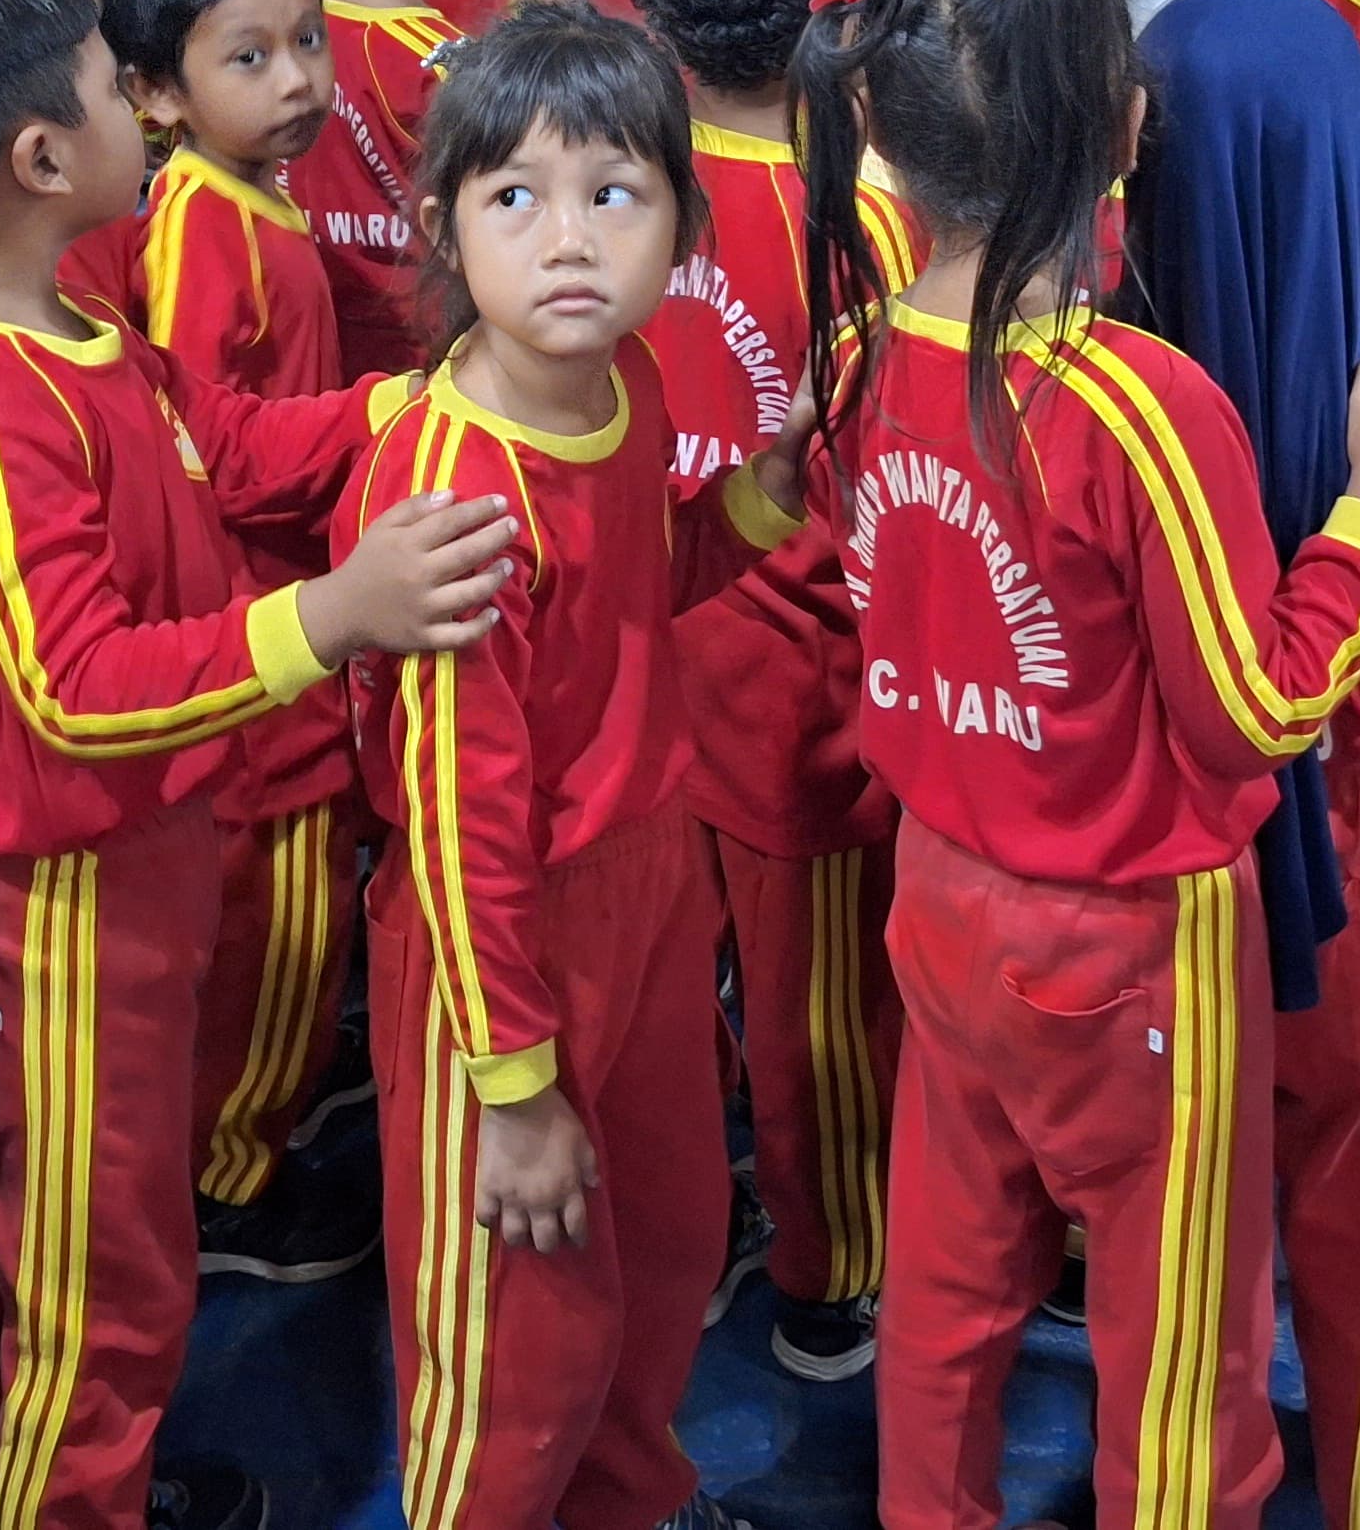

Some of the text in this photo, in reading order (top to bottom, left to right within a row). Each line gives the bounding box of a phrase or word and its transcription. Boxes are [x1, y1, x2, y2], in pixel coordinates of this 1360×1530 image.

[325, 212, 410, 247] WARU
[665, 254, 791, 434] ANITA PERSATUAN
[971, 501, 1070, 688] PERSATUAN
